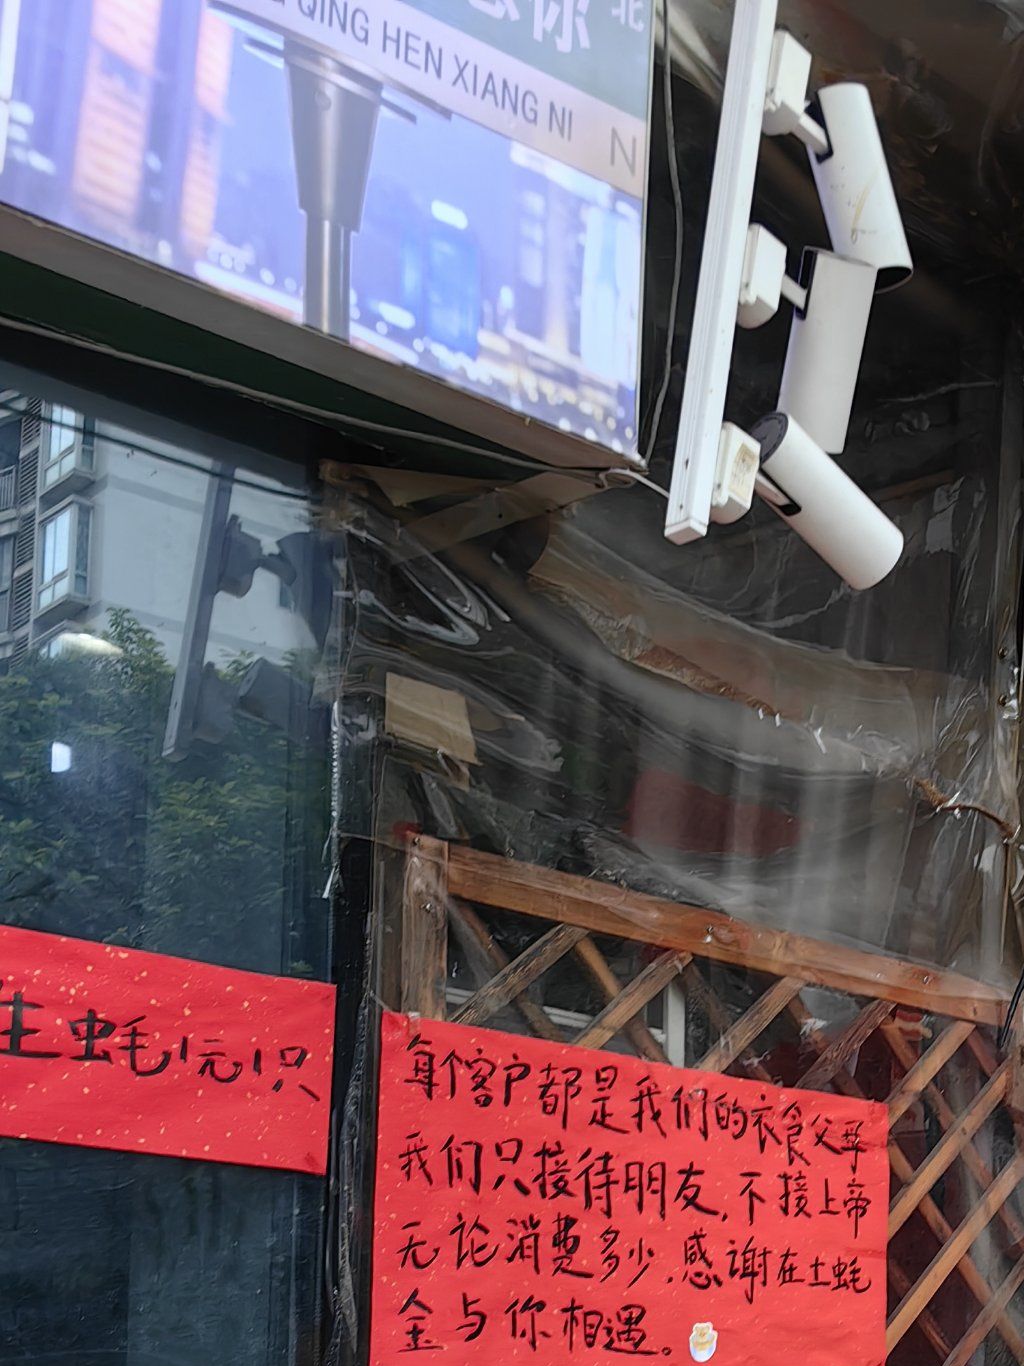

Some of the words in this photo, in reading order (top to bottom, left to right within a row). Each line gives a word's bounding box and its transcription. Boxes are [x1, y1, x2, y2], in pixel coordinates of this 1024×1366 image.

[298, 0, 369, 46] QING
[382, 20, 443, 80] HEN
[451, 53, 539, 126] XIANG
[548, 101, 573, 142] NI
[610, 126, 637, 177] N
[403, 1033, 868, 1174] 每个客户都是我们的衣食父母
